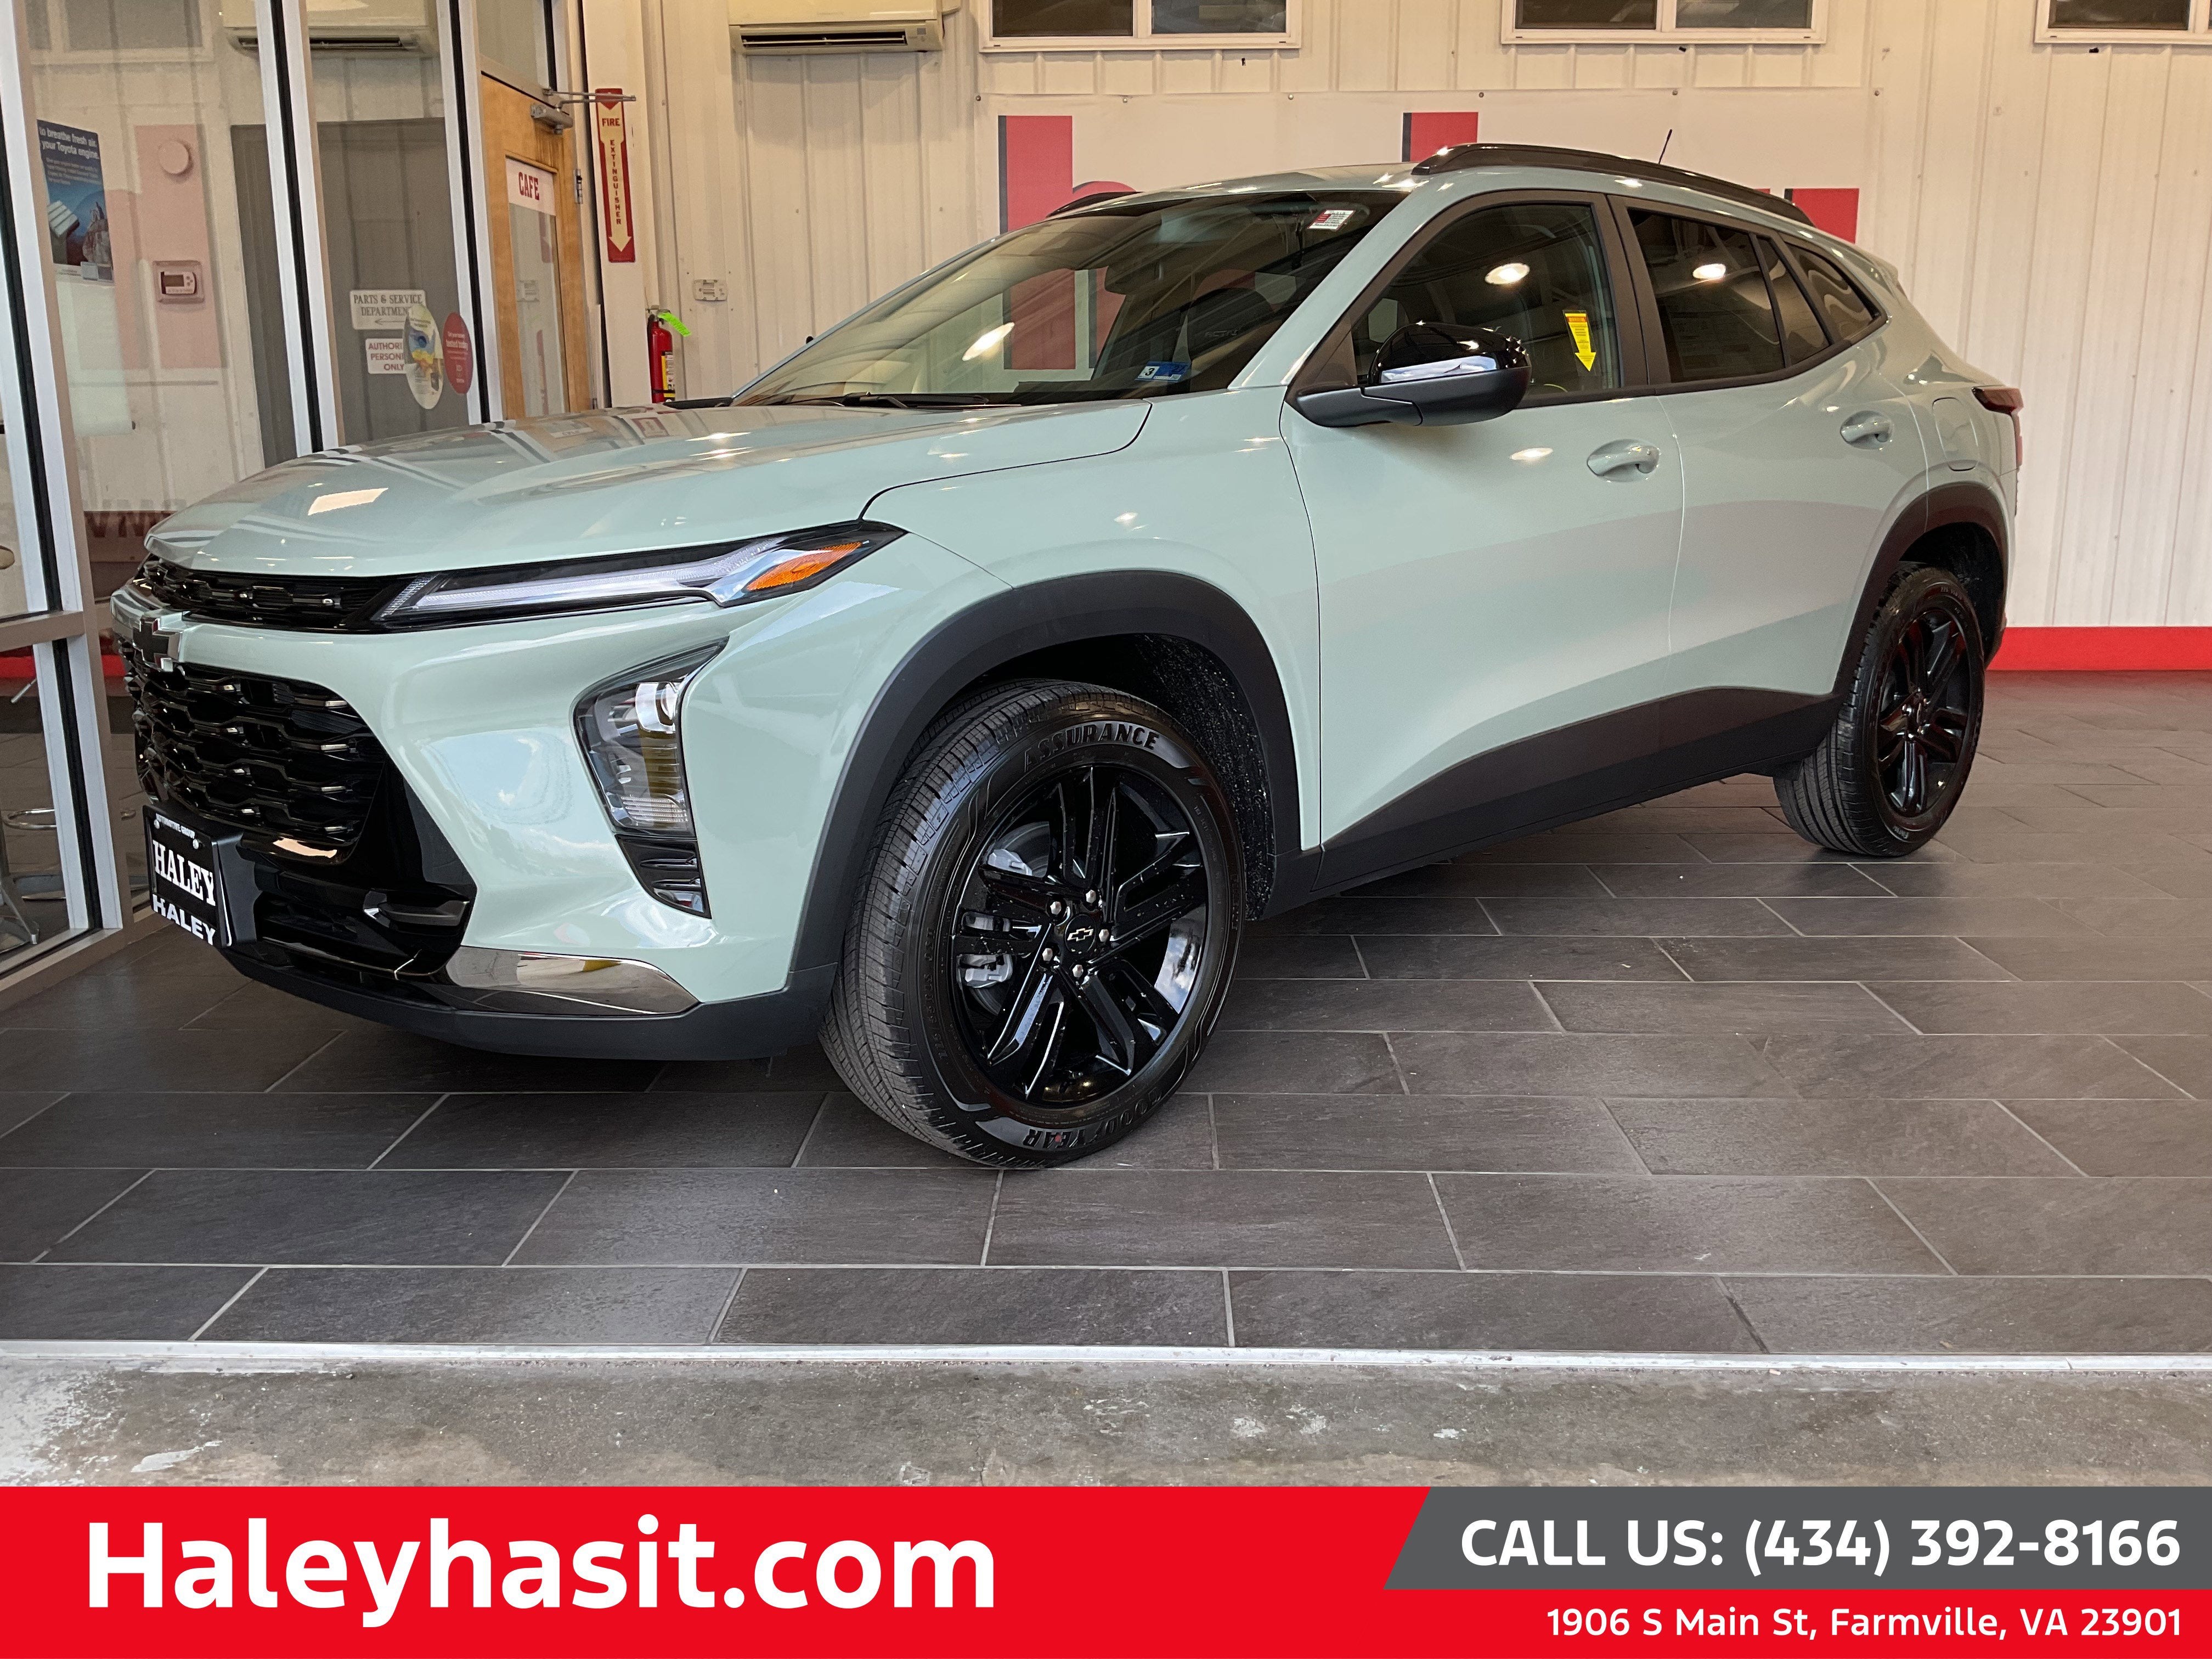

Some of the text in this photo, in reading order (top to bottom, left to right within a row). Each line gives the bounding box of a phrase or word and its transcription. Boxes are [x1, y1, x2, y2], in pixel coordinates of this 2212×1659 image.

[602, 118, 620, 127] FIRE
[47, 128, 71, 142] breathe
[71, 133, 88, 145] fresh
[41, 140, 56, 150] your
[57, 142, 77, 154] Toyota
[518, 171, 540, 201] CAFE
[610, 139, 622, 225] EXTINGUISHER
[353, 294, 422, 304] PARTS & SERVICE
[361, 307, 408, 316] DEPARTMEN
[1145, 368, 1155, 376] 3
[1024, 722, 1159, 772] ASSURANCE
[152, 839, 216, 906] HALEY
[152, 894, 216, 946] HALEY
